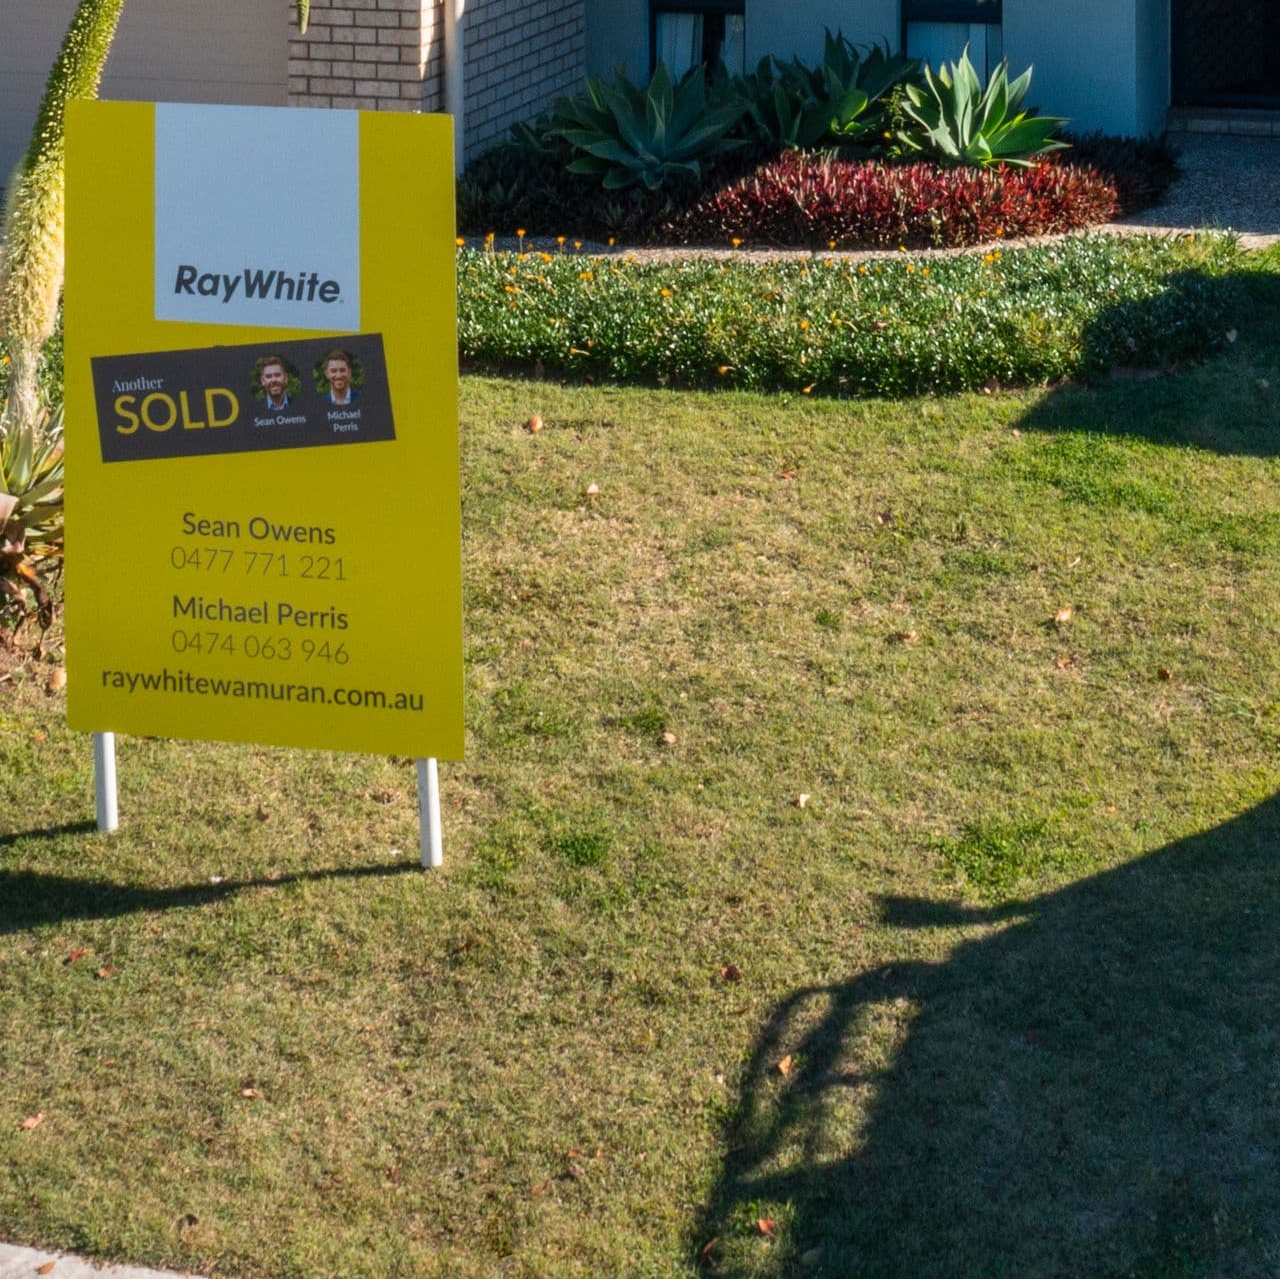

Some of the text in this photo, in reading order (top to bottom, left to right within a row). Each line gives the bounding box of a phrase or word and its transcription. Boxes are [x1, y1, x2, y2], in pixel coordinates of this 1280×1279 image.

[174, 264, 341, 304] RayWhite
[112, 376, 164, 393] Another
[114, 388, 240, 435] SOLD
[254, 415, 307, 427] Sean Owens
[327, 408, 362, 421] Michael
[333, 422, 359, 433] Perris
[182, 512, 336, 545] Sean Owens
[170, 546, 347, 581] 0477 771 221
[172, 595, 349, 630] Michael Perris
[171, 630, 350, 665] 0474 063 946
[102, 668, 425, 712] raywhitewamuran.com.au
